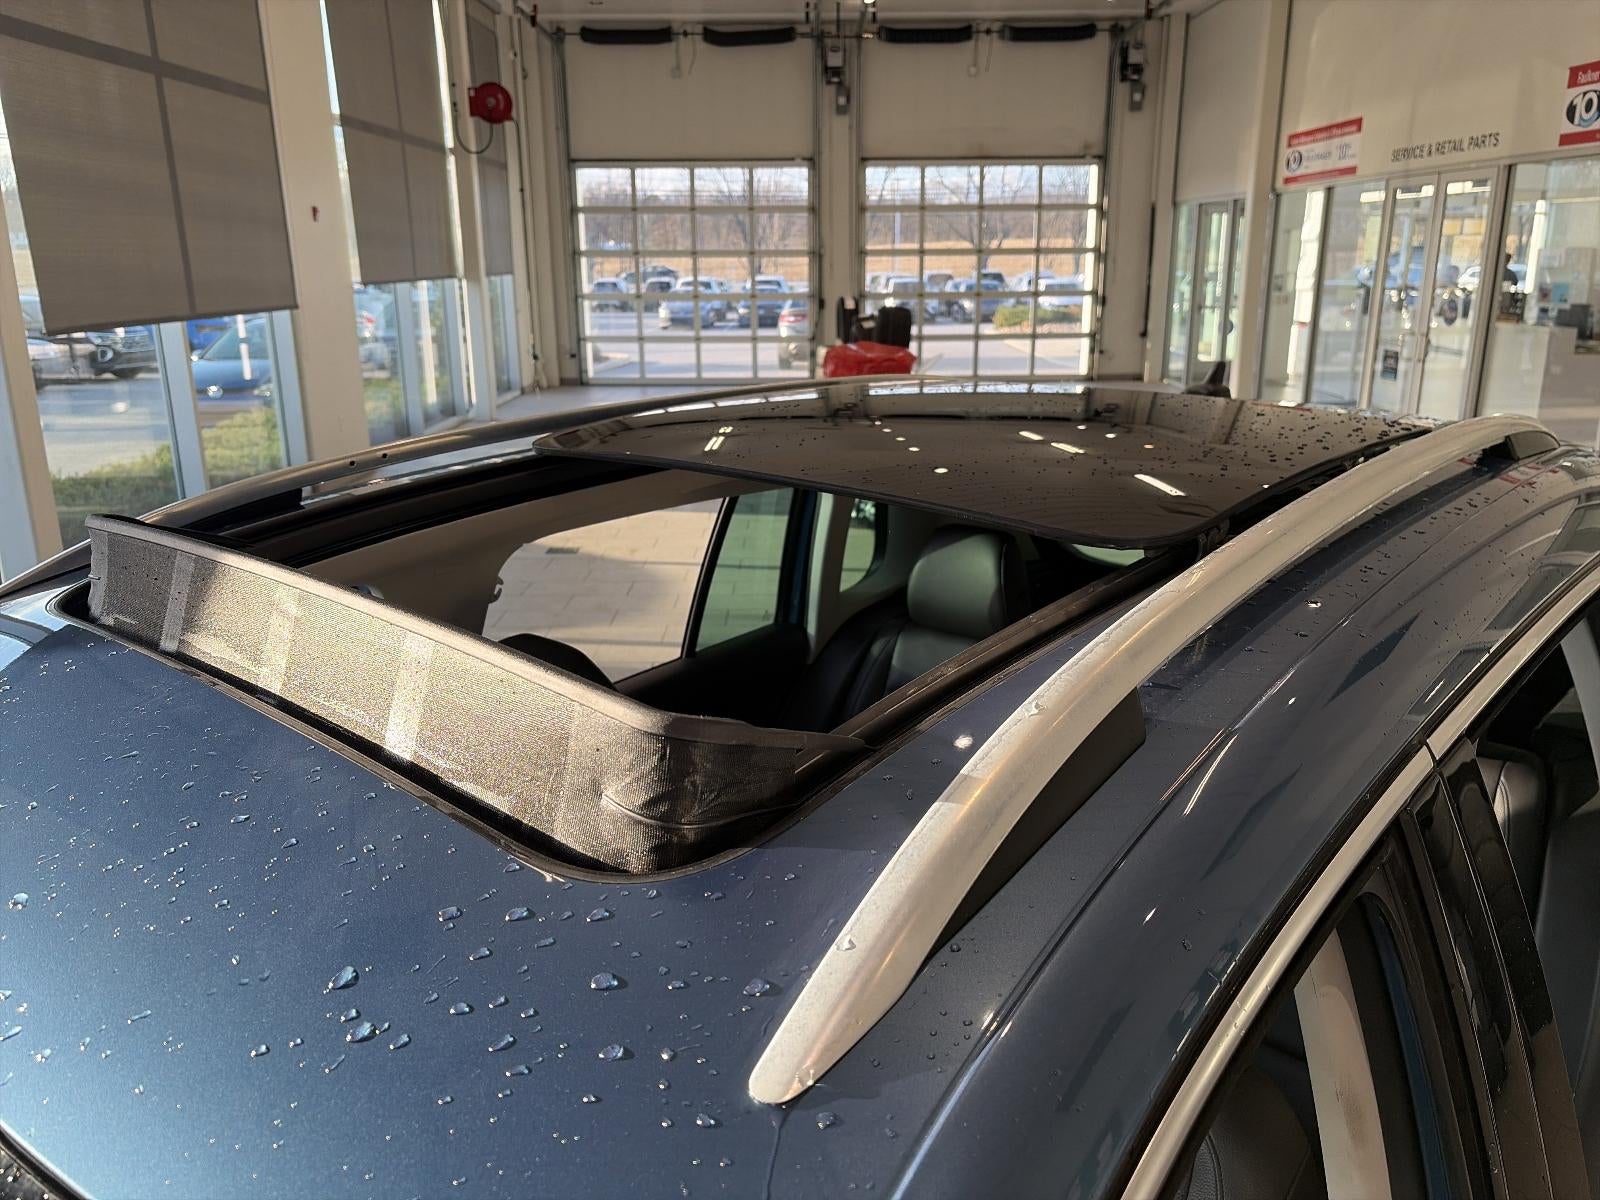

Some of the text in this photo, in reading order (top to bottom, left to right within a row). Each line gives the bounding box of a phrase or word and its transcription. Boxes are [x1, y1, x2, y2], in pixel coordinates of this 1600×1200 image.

[1391, 132, 1500, 162] SERVICE & RETAIL PARTS
